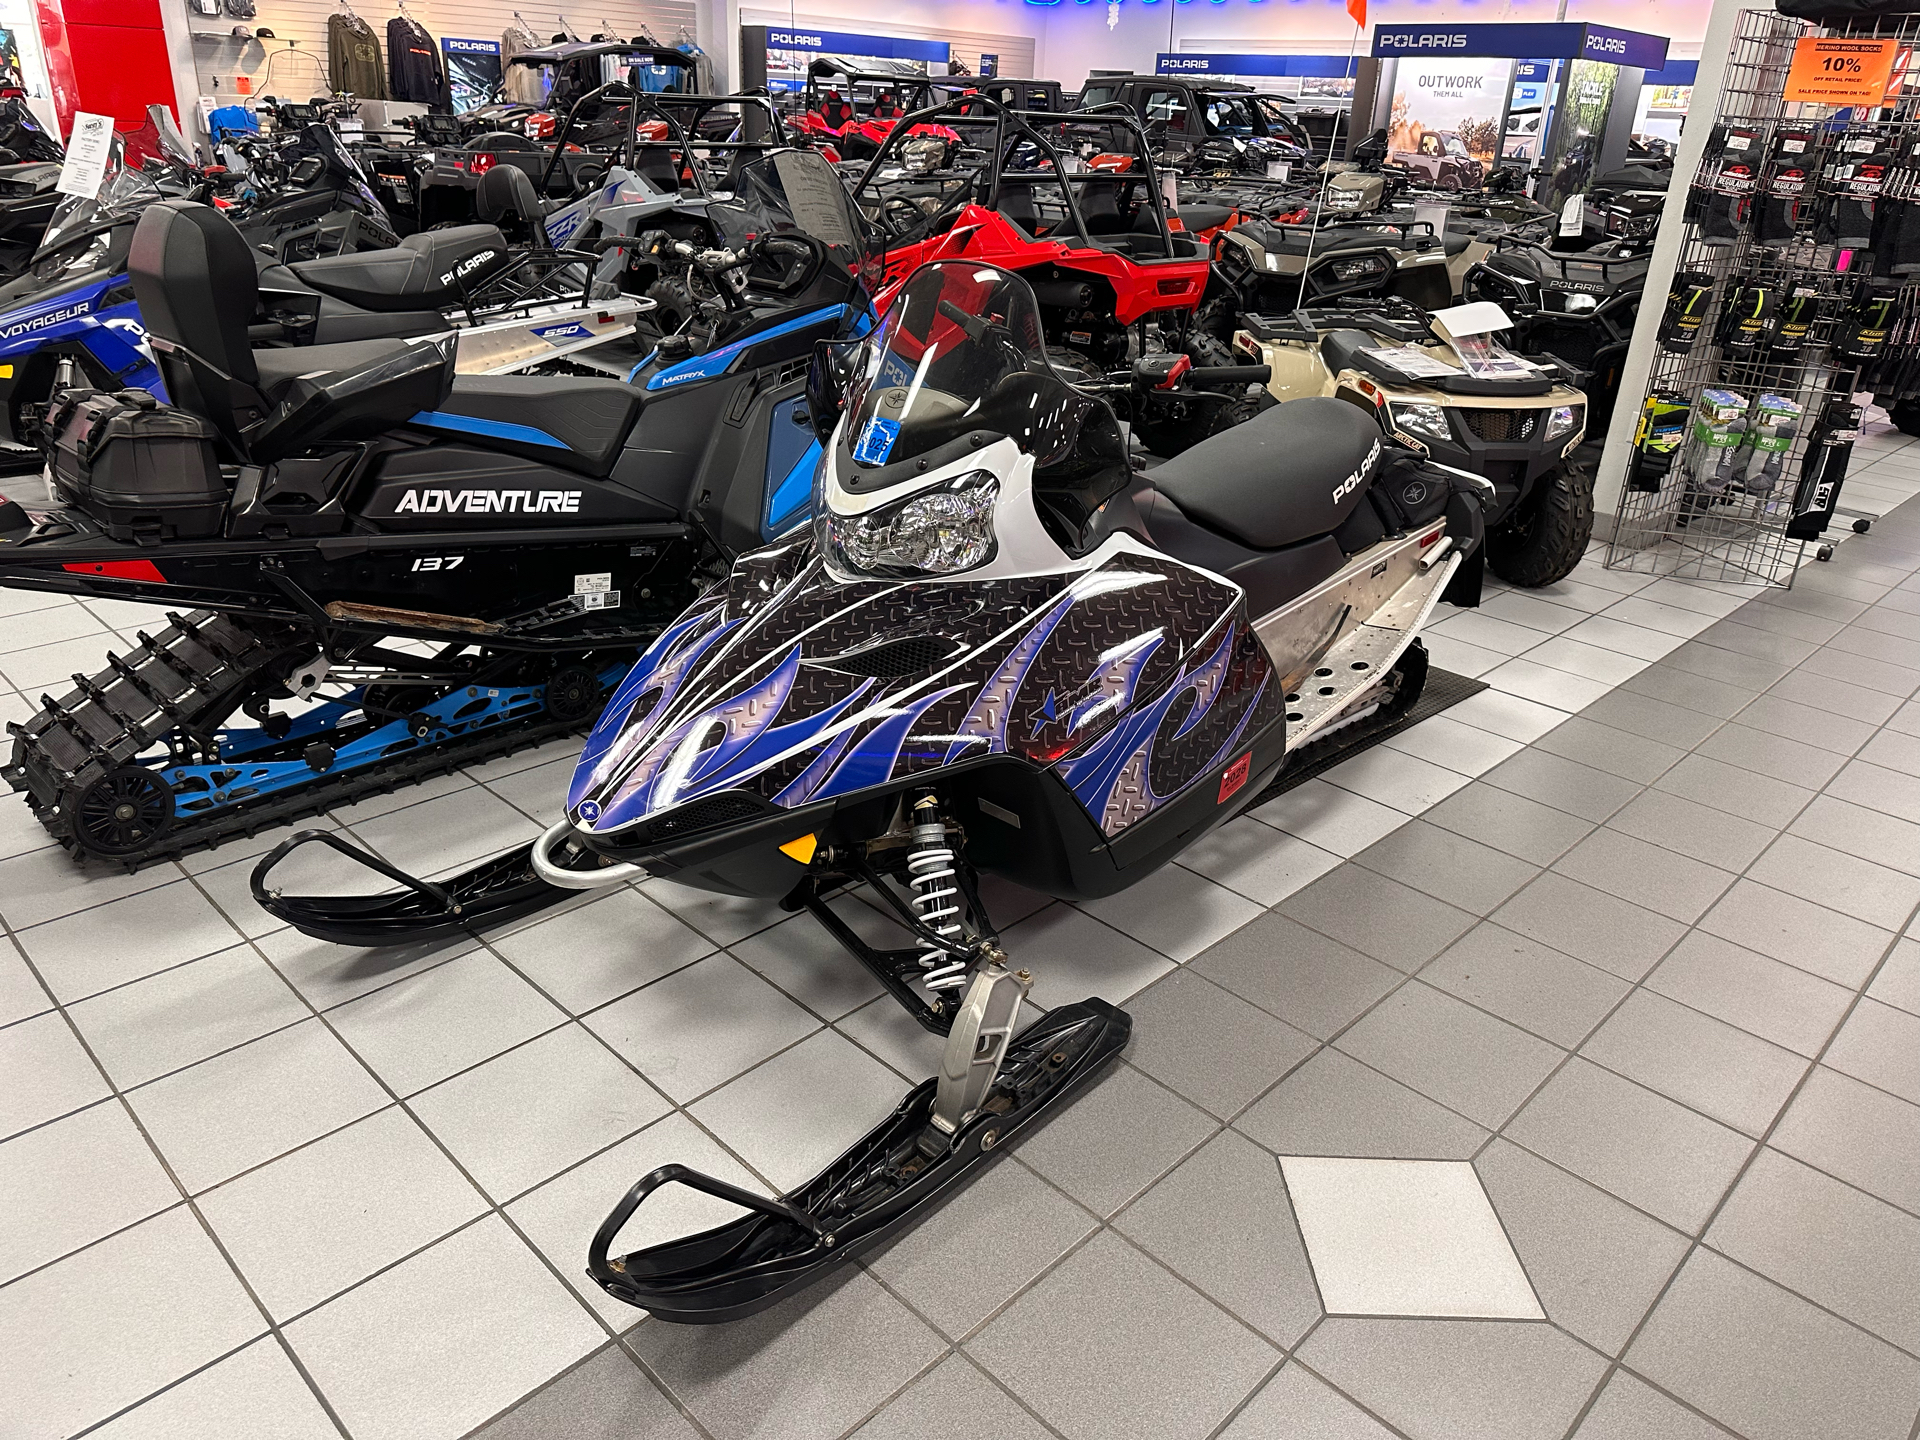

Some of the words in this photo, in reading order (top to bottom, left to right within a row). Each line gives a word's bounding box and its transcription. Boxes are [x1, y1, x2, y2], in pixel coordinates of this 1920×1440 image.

[771, 33, 822, 46] POLARIS
[1380, 34, 1467, 48] POLARIS
[1586, 34, 1627, 54] POLARIS
[450, 41, 496, 52] POLARIS
[1161, 60, 1209, 69] POLARIS
[1822, 57, 1862, 73] 10%
[1418, 75, 1483, 88] OUTWORK
[1433, 90, 1448, 98] THEM
[27, 170, 60, 183] OLARIS
[1772, 181, 1804, 191] REGULATOR
[1849, 182, 1881, 192] REGULATOR
[1550, 279, 1605, 292] POLARIS
[0, 302, 90, 339] VOYAGEUR
[543, 325, 580, 338] 550
[662, 370, 705, 386] MATRYX
[868, 437, 890, 452] 025
[1393, 431, 1411, 446] ARCTIC
[1411, 441, 1423, 450] CAT
[1332, 437, 1382, 505] POLARIS
[395, 489, 582, 513] ADVENTURE
[411, 556, 464, 571] 137
